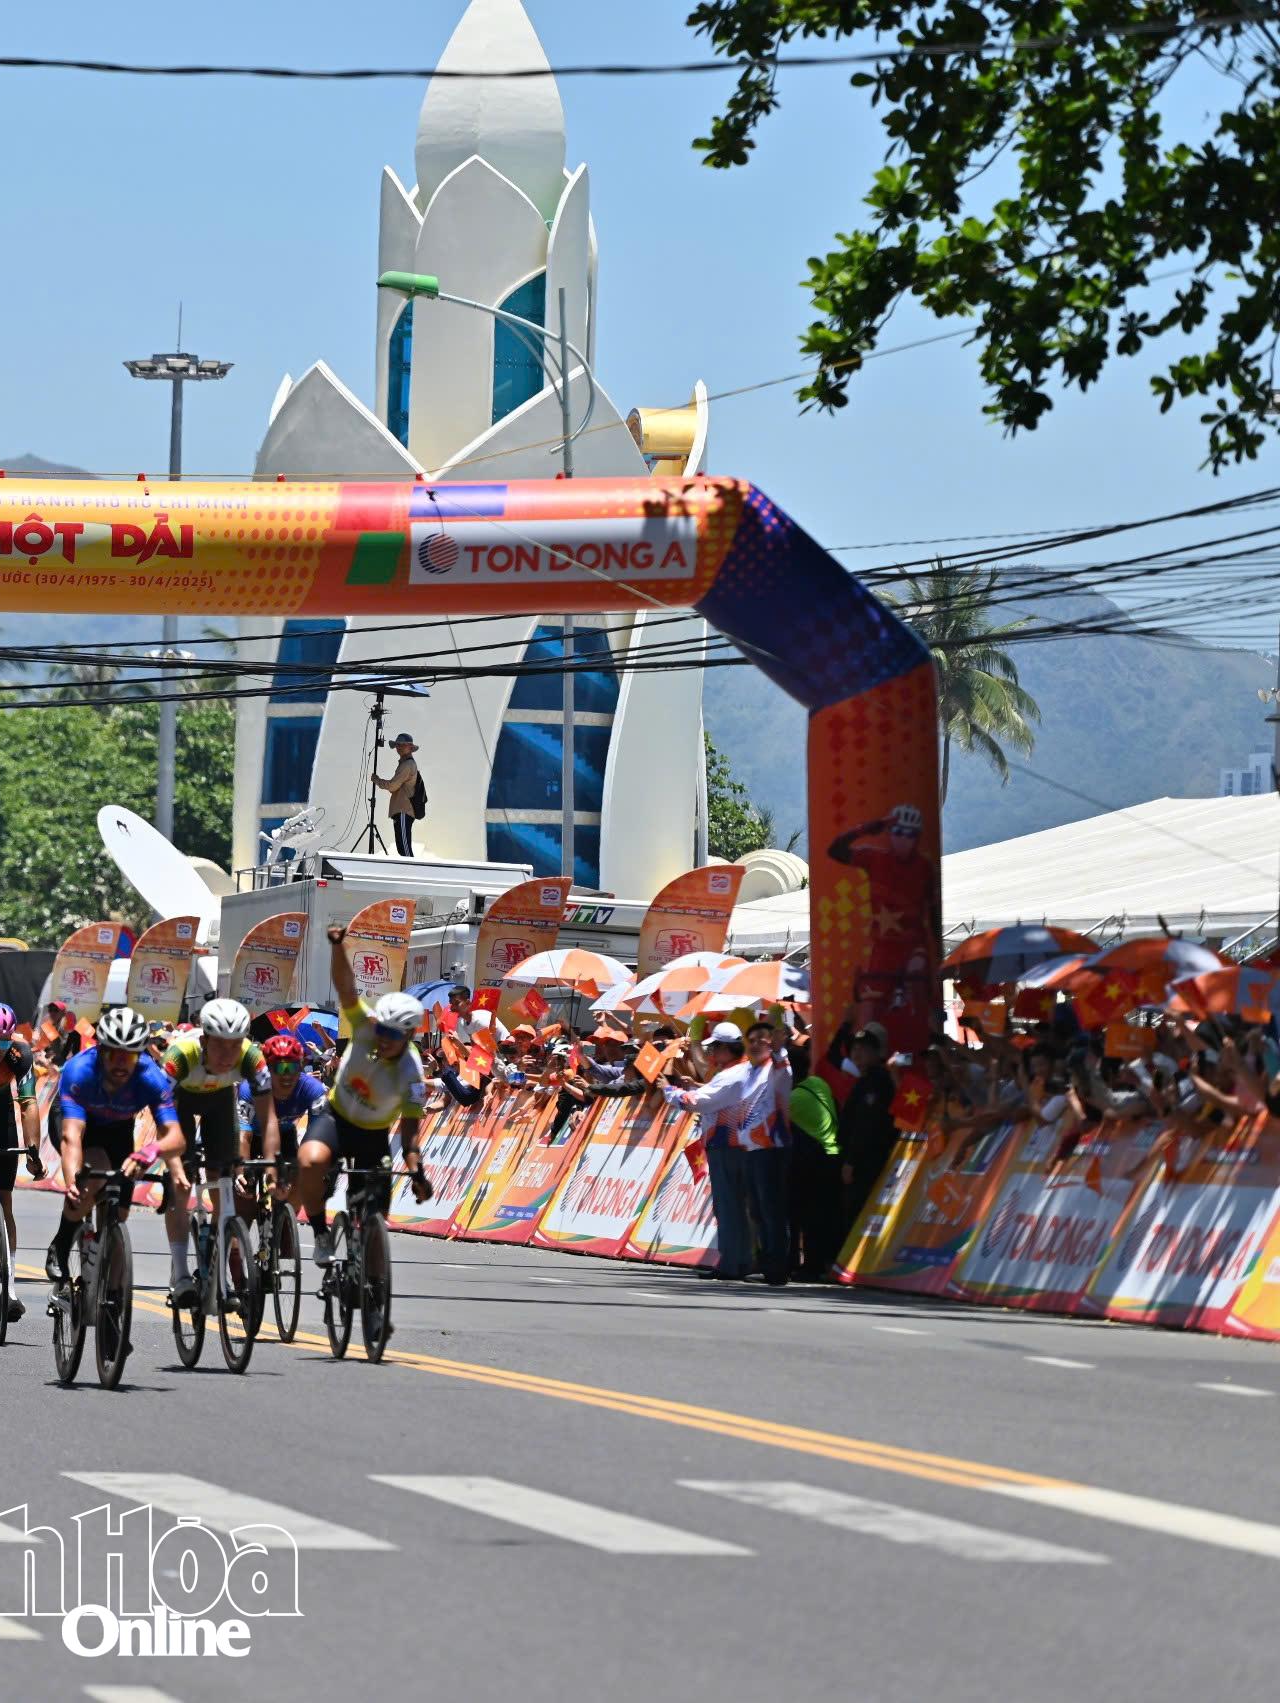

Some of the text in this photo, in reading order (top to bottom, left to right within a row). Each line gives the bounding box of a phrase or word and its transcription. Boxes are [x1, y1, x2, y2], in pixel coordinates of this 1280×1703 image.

[464, 541, 688, 573] TON DONG A
[564, 907, 613, 925] HTV
[591, 1177, 637, 1219] DONG
[1032, 1214, 1096, 1266] DONG
